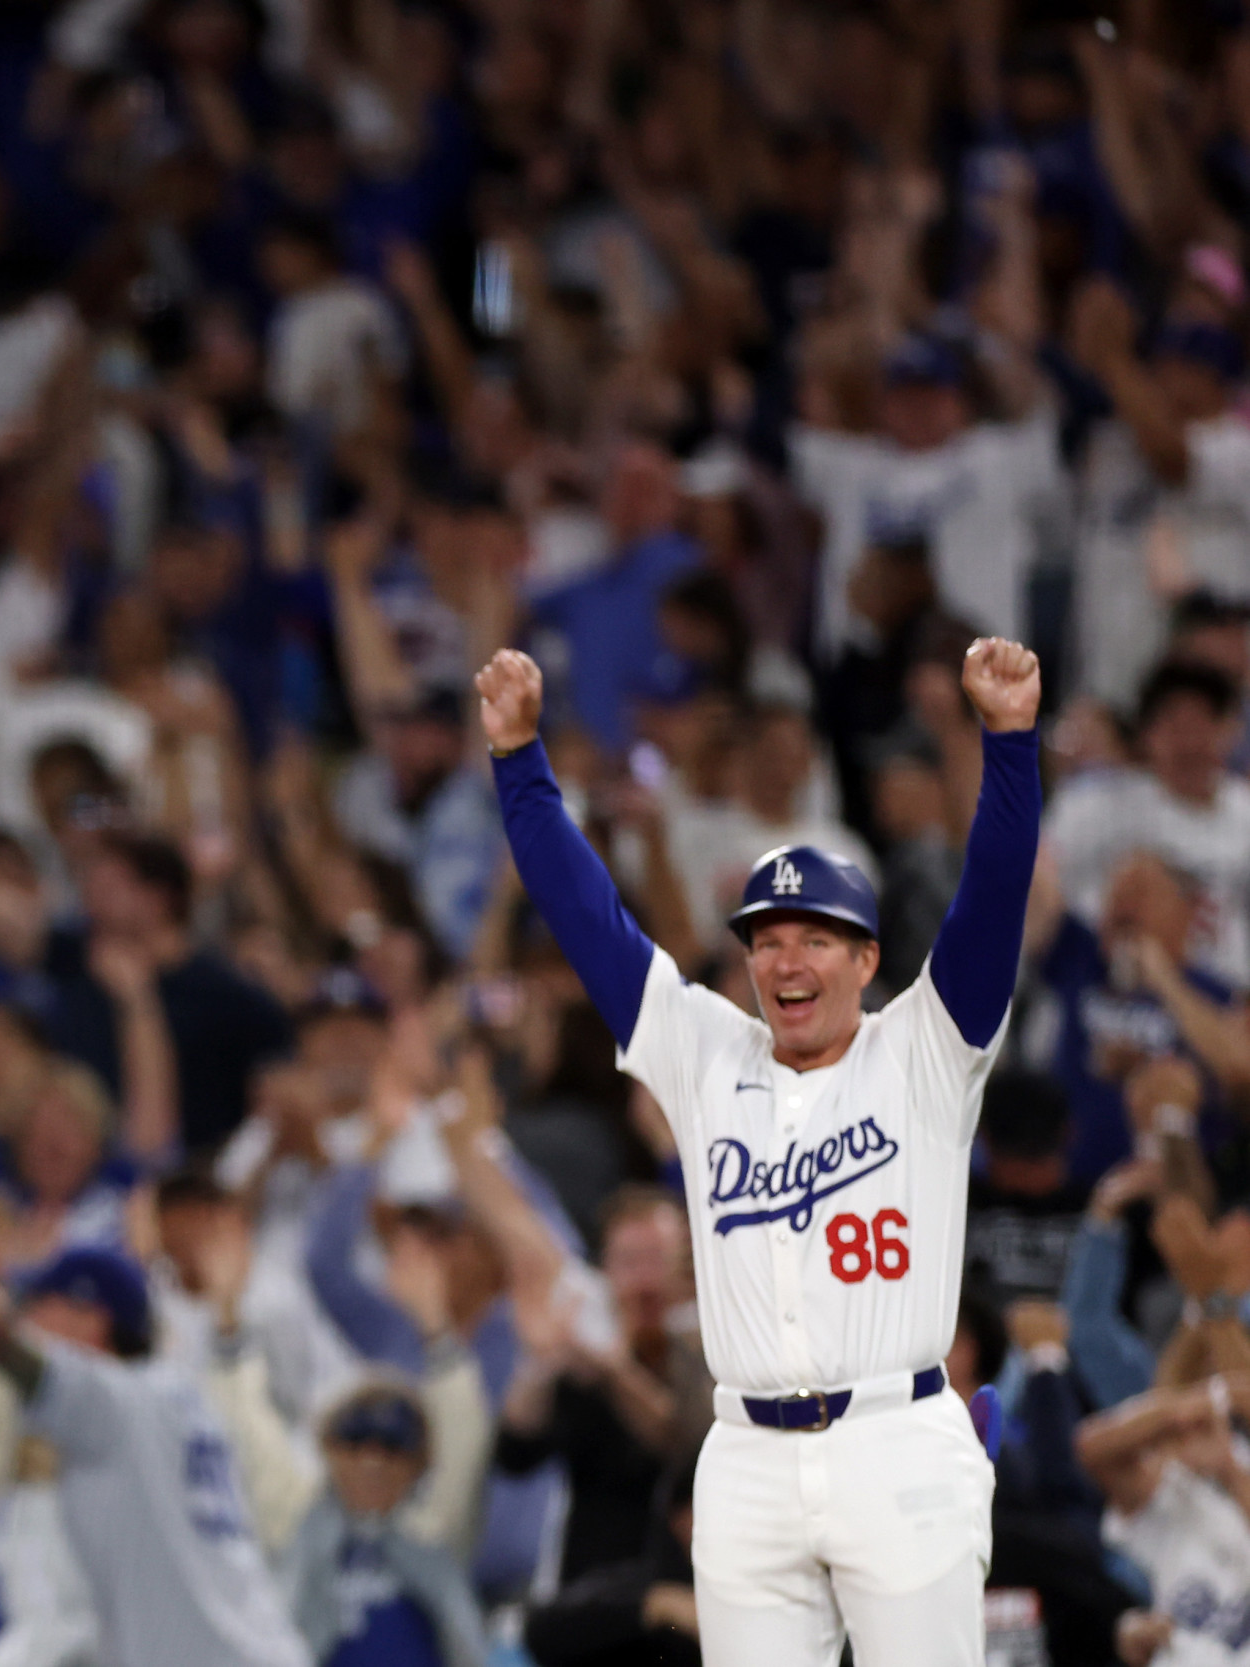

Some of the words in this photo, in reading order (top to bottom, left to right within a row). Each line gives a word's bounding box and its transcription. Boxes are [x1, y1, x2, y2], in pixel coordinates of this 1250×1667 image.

[771, 855, 803, 896] LA
[709, 1117, 899, 1237] Dodgers
[825, 1207, 910, 1286] 86
